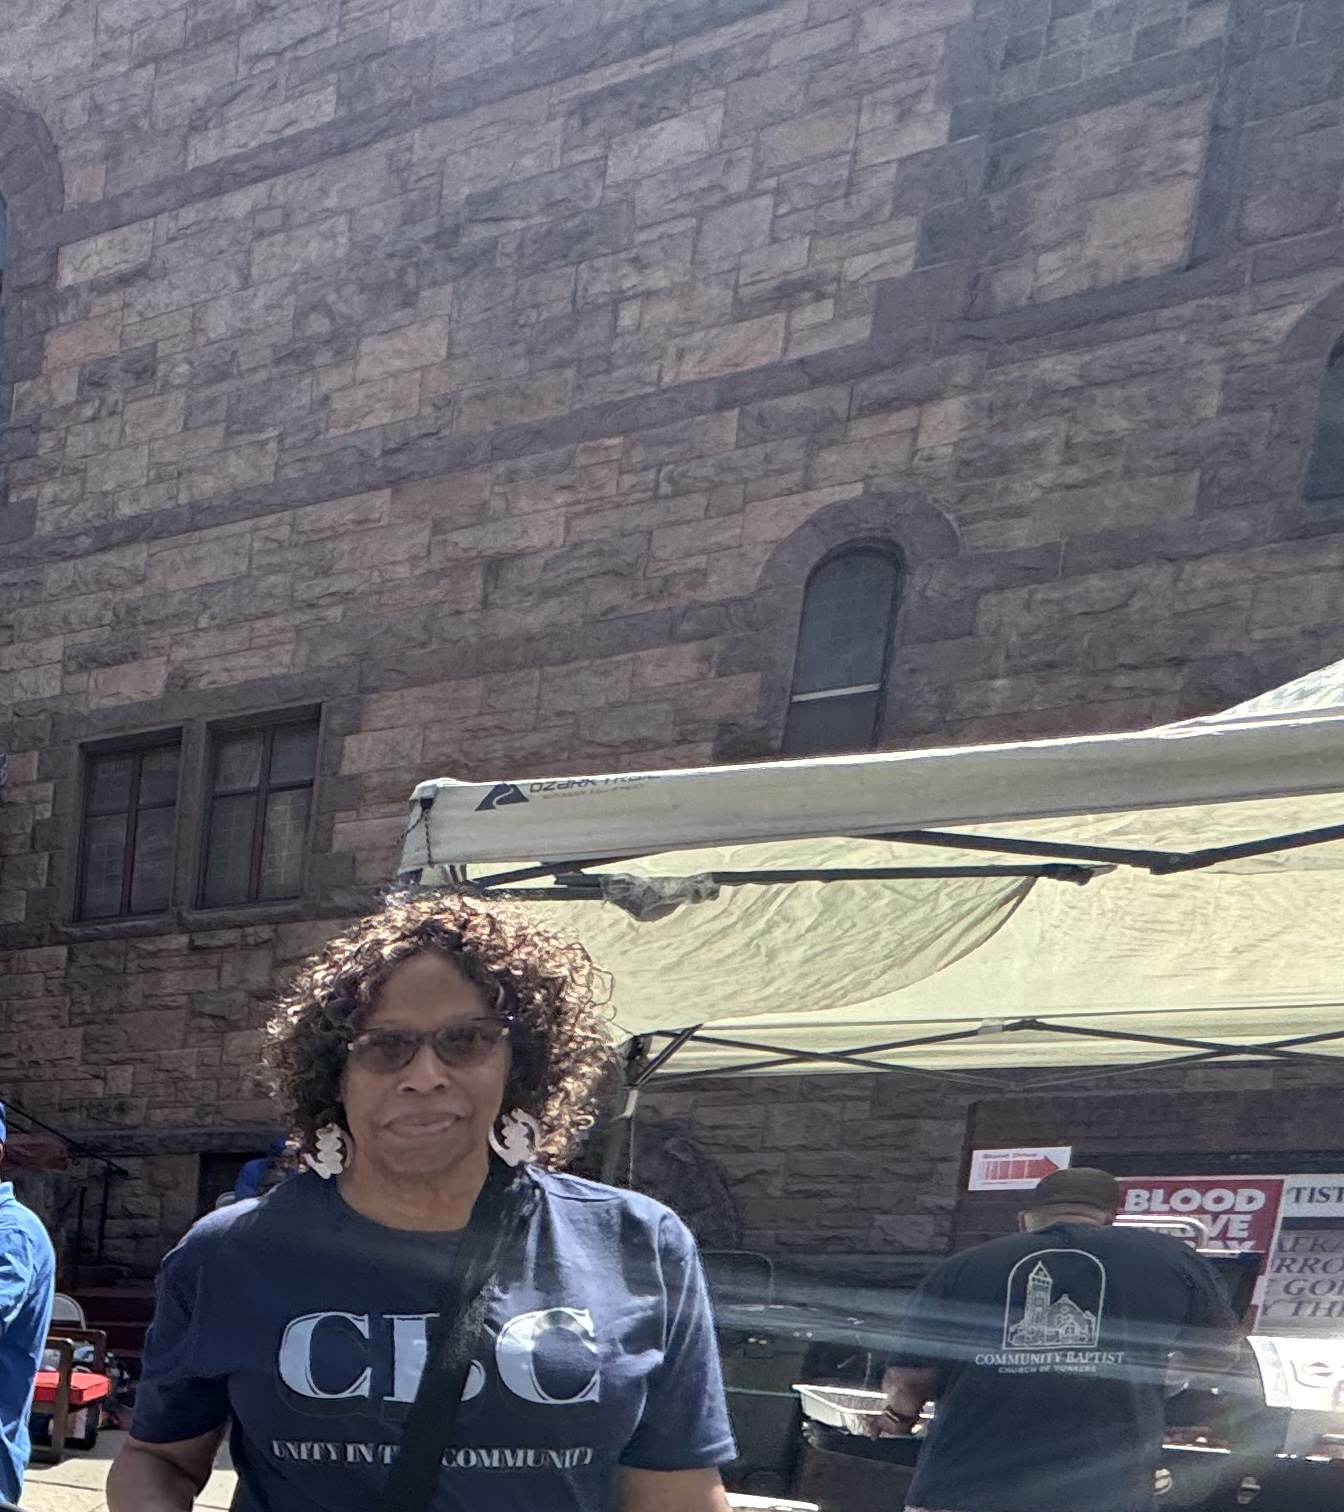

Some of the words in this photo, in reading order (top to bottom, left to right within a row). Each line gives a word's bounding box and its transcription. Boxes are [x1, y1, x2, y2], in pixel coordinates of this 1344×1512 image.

[1124, 1187, 1266, 1213] BLOOD
[974, 1352, 1064, 1366] COMMUNITY
[1065, 1351, 1126, 1364] BAPTIST
[272, 1440, 338, 1461] UNITY
[344, 1442, 374, 1463] IN
